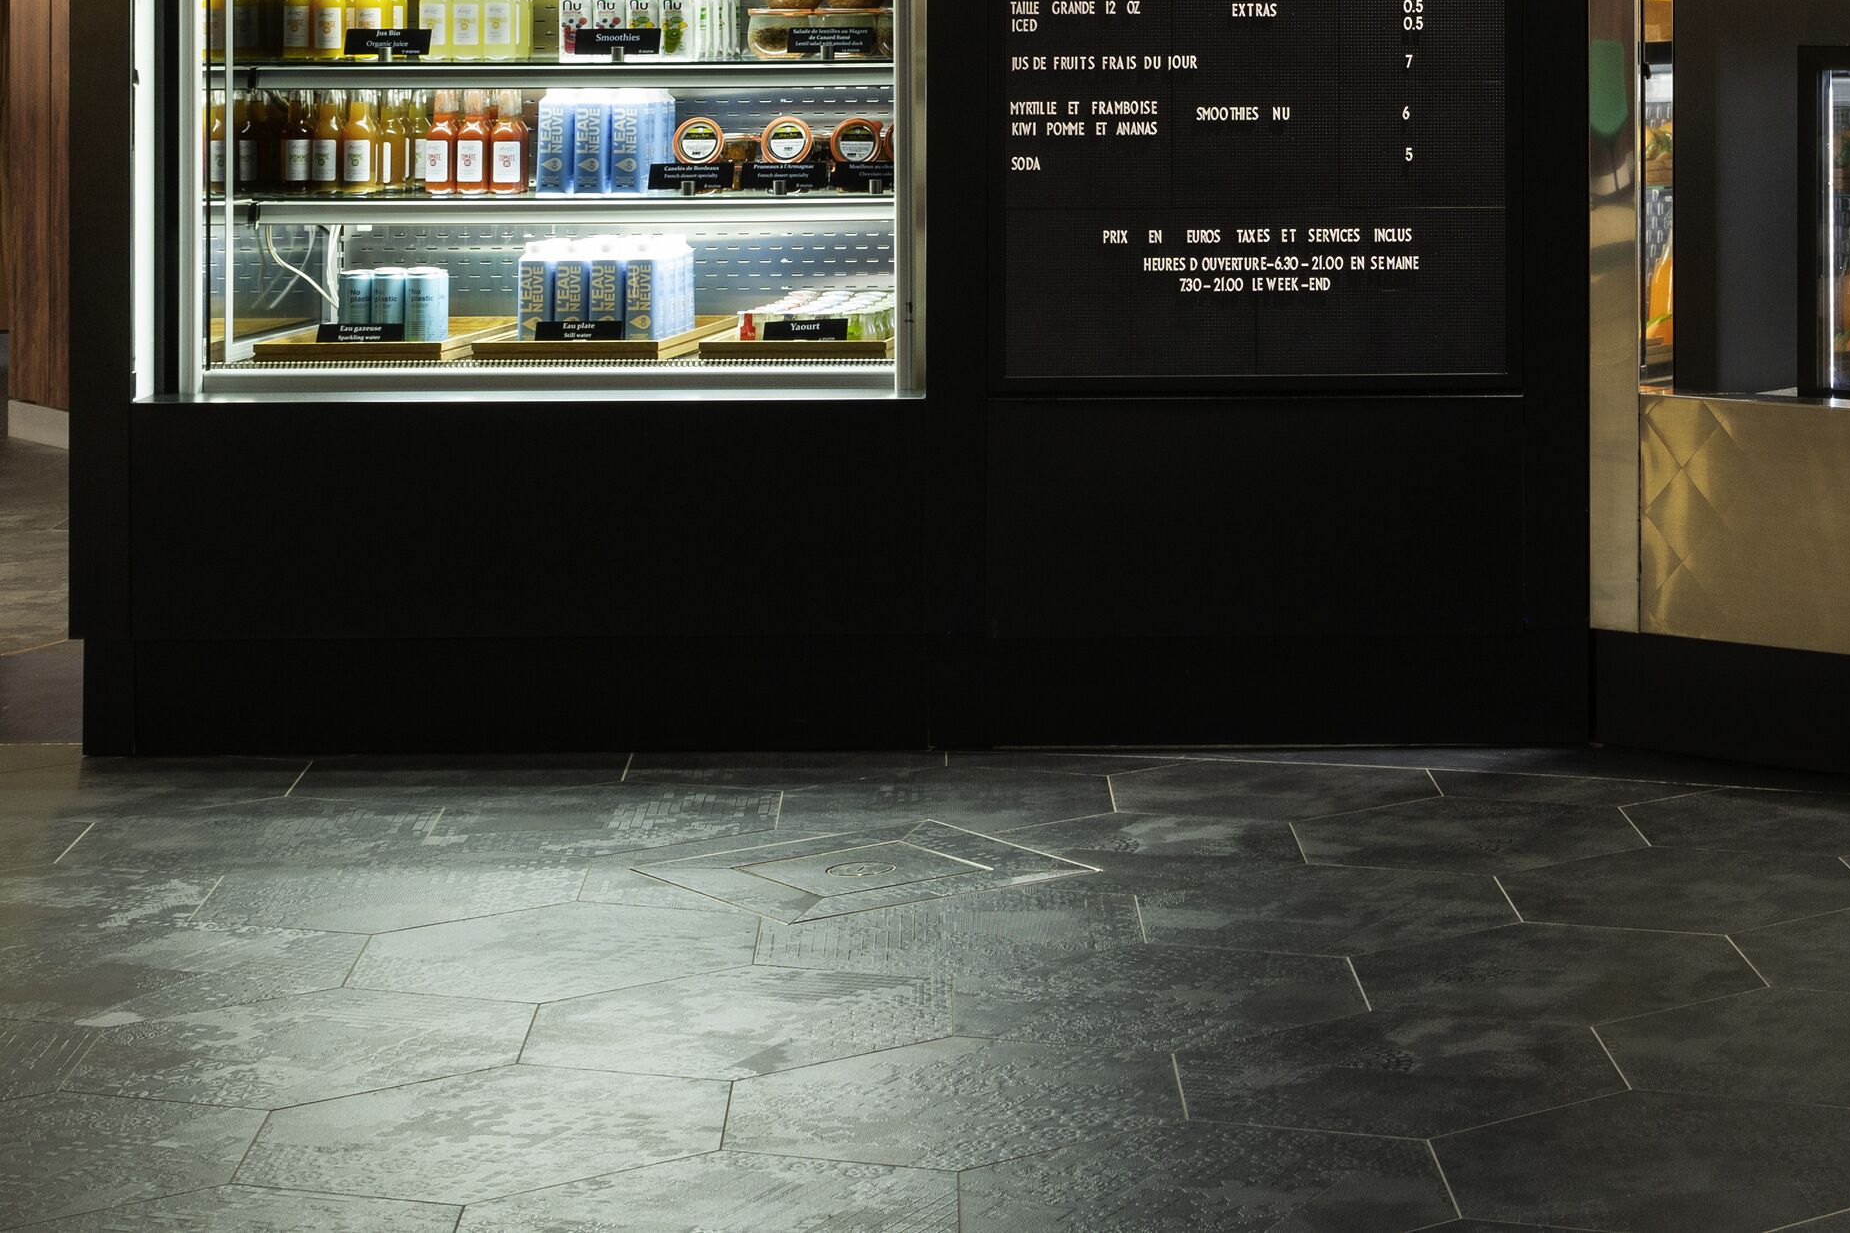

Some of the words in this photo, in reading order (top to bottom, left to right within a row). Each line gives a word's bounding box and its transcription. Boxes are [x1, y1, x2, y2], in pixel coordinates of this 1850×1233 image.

[1010, 0, 1040, 15] TAILLE
[1051, 0, 1096, 15] GRANDE
[1126, 0, 1141, 15] OZ
[1231, 2, 1278, 18] EXTRAS
[1011, 18, 1038, 33] ICED
[1403, 15, 1424, 31] 0.5
[366, 40, 392, 48] Organic
[391, 40, 409, 48] juice
[595, 33, 641, 42] Smoothies
[1011, 56, 1030, 72] JUS
[1032, 56, 1047, 71] DE
[1053, 55, 1096, 70] FRUITS
[1102, 55, 1137, 70] FRAIS
[1143, 55, 1162, 70] DU
[1167, 54, 1198, 71] JOUR
[1405, 54, 1414, 69] 7
[1009, 101, 1057, 115] MYRTILLE
[1067, 101, 1080, 115] ET
[1091, 100, 1158, 115] FRAMBOISE
[1195, 106, 1260, 121] SMOOTHIES
[1272, 106, 1291, 121] NU
[1401, 105, 1411, 121] 6
[552, 108, 564, 154] NEUVE
[589, 107, 600, 154] NEUVE
[626, 107, 638, 154] NEUVE
[1011, 121, 1037, 136] KIWI
[1046, 121, 1085, 136] POMME
[1095, 121, 1108, 136] ET
[1115, 121, 1158, 136] ANANAS
[1405, 147, 1414, 162] 5
[1011, 156, 1041, 171] SODA
[1102, 229, 1128, 244] PRIX
[1148, 229, 1163, 244] EN
[1186, 228, 1221, 244] EUROS
[1236, 228, 1271, 244] TAXES
[1281, 228, 1297, 243] ET
[1307, 227, 1361, 243] SERVICES
[1374, 227, 1413, 243] INCLUS
[1143, 256, 1187, 272] HEURES
[1350, 255, 1365, 271] EN
[1370, 255, 1420, 270] SEMAINE
[533, 266, 544, 313] NEUVE
[570, 265, 581, 312] NEUVE
[604, 265, 616, 311] NEUVE
[639, 264, 651, 311] NEUVE
[1252, 277, 1264, 292] LE
[577, 322, 596, 331] plate
[790, 322, 821, 331] Yaourt
